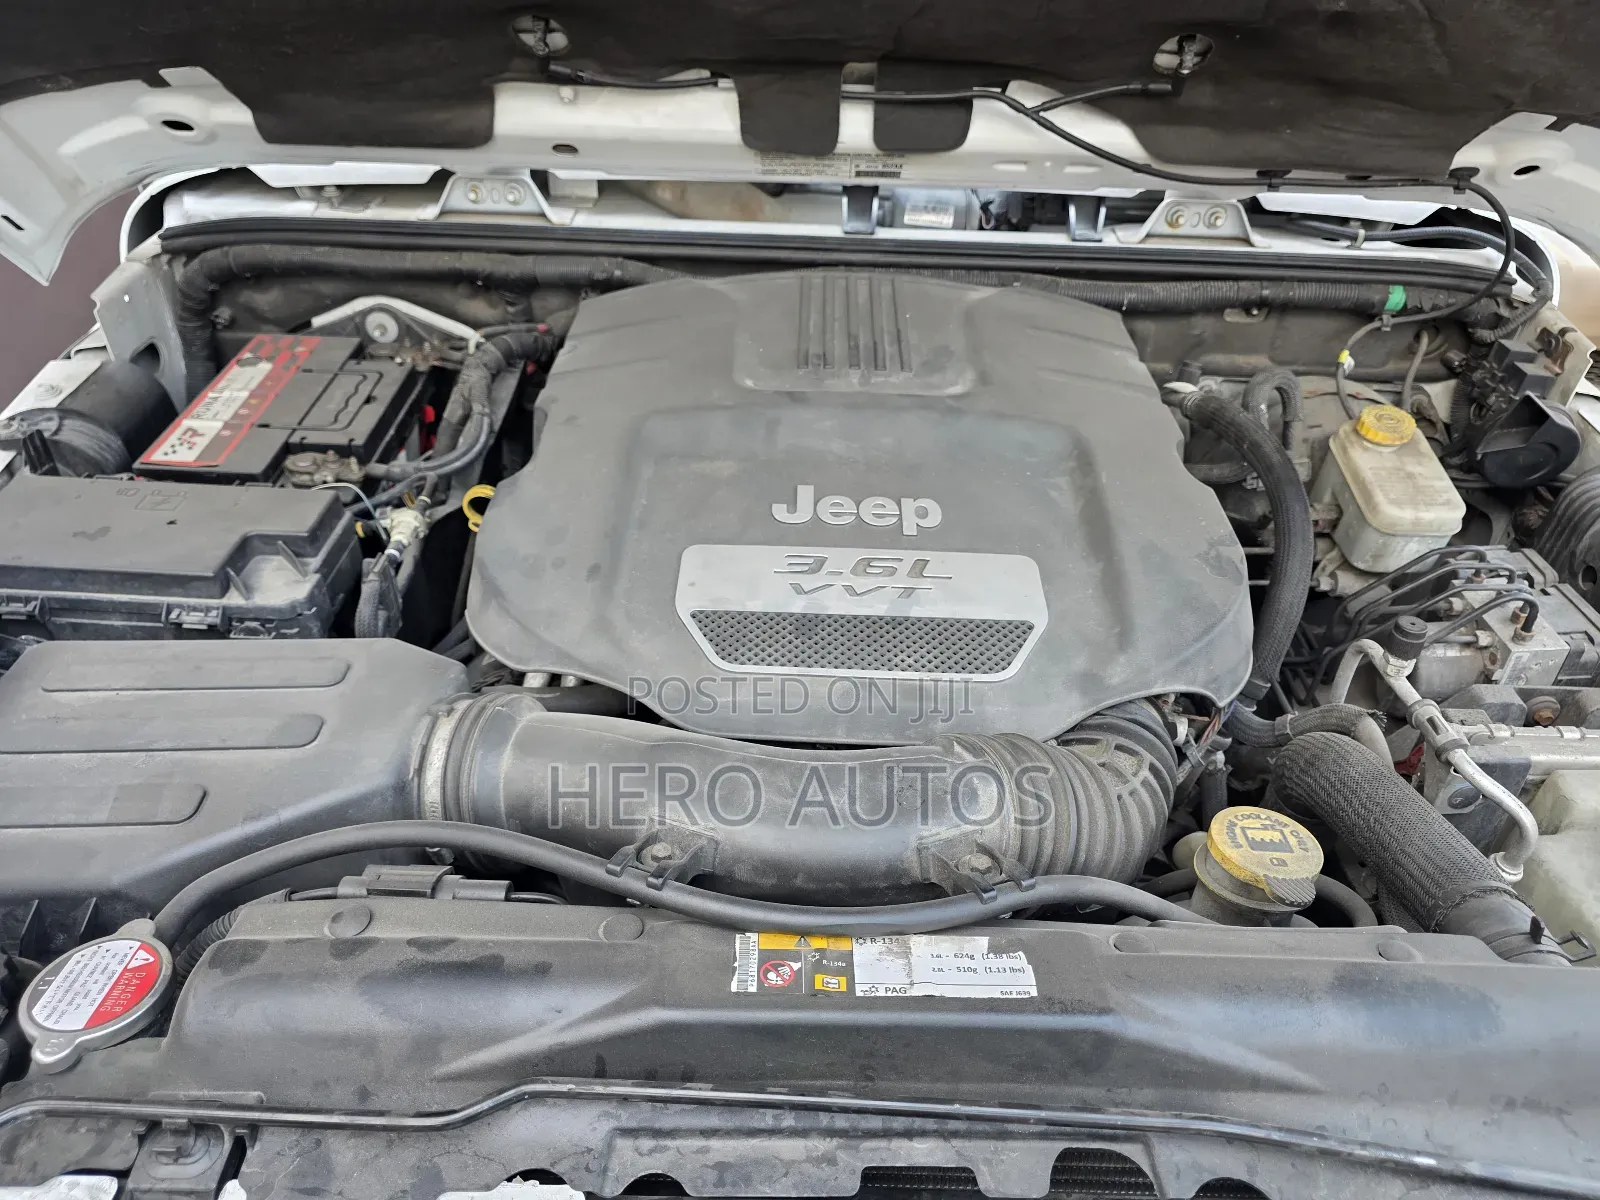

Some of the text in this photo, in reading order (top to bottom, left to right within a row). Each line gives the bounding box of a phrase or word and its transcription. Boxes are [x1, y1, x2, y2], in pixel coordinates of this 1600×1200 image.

[771, 484, 942, 536] Jeep
[773, 553, 953, 579] 3.6L
[788, 582, 932, 599] VVT
[1225, 812, 1310, 853] ENGINE COOLANT ONLY
[953, 952, 976, 960] 624g
[956, 966, 979, 974] 510g
[984, 966, 1007, 974] (1.13
[1009, 966, 1026, 974] lbs)
[100, 972, 134, 1012] WARNING
[112, 972, 146, 1012] DANGER
[884, 986, 907, 995] PAG
